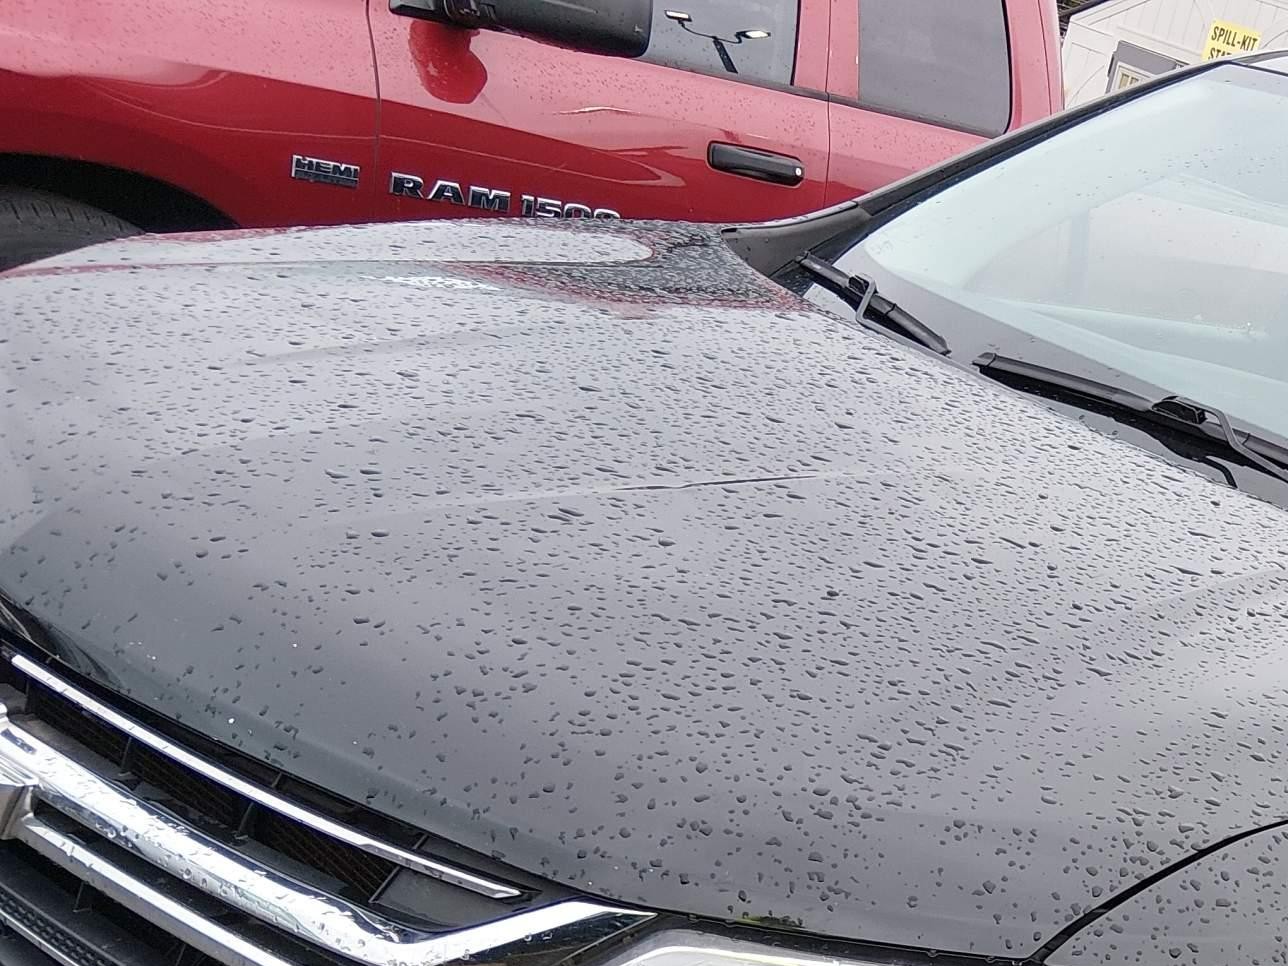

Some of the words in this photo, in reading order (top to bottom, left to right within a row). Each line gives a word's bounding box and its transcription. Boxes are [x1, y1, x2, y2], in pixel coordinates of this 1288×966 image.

[1211, 25, 1259, 52] SPILL-KIT
[292, 155, 360, 181] HEMI
[390, 171, 512, 213] RAM
